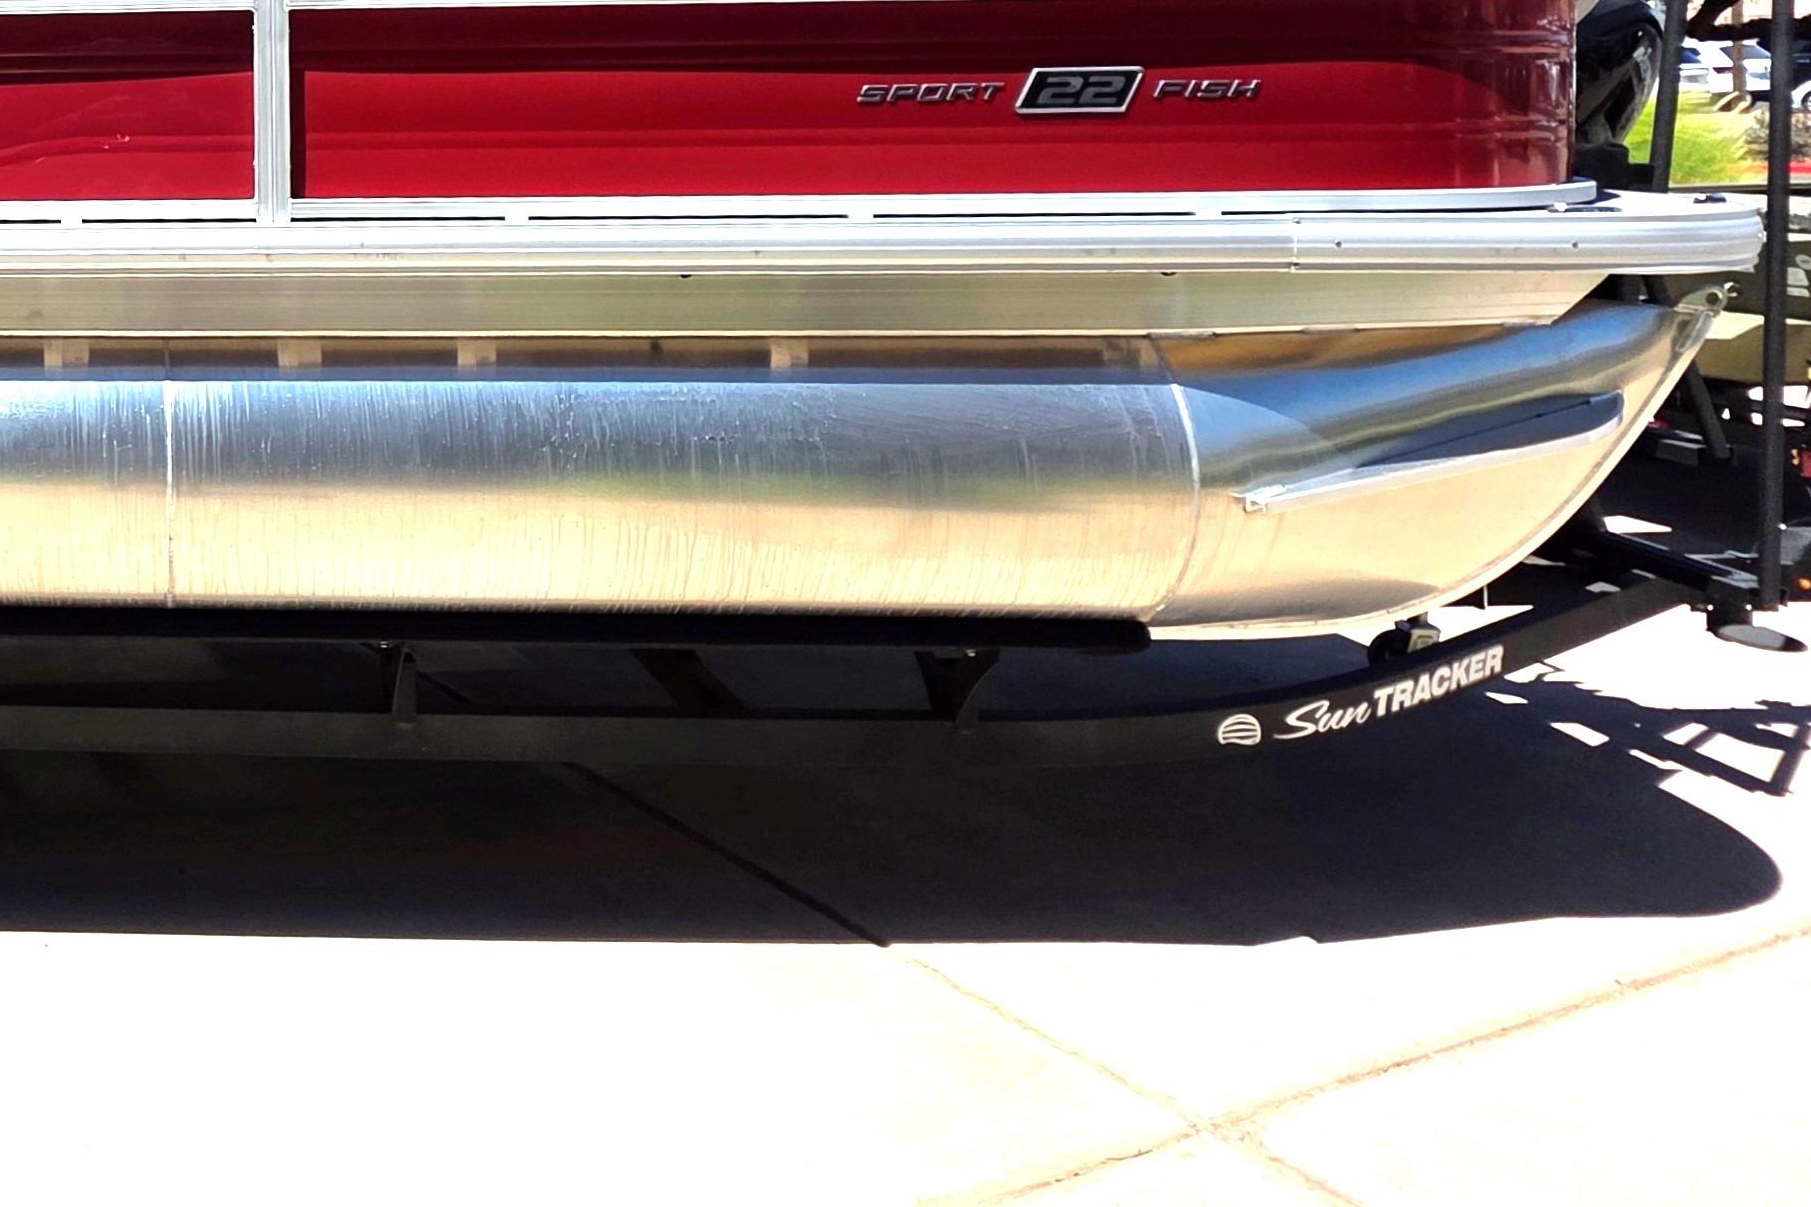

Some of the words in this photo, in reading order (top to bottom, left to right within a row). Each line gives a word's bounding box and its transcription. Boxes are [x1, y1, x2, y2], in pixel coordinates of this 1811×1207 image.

[856, 82, 1005, 104] SPORT
[1039, 76, 1125, 105] 22
[1153, 78, 1262, 99] FISH
[1273, 700, 1372, 740] Sun
[1374, 645, 1505, 718] TRACKER
